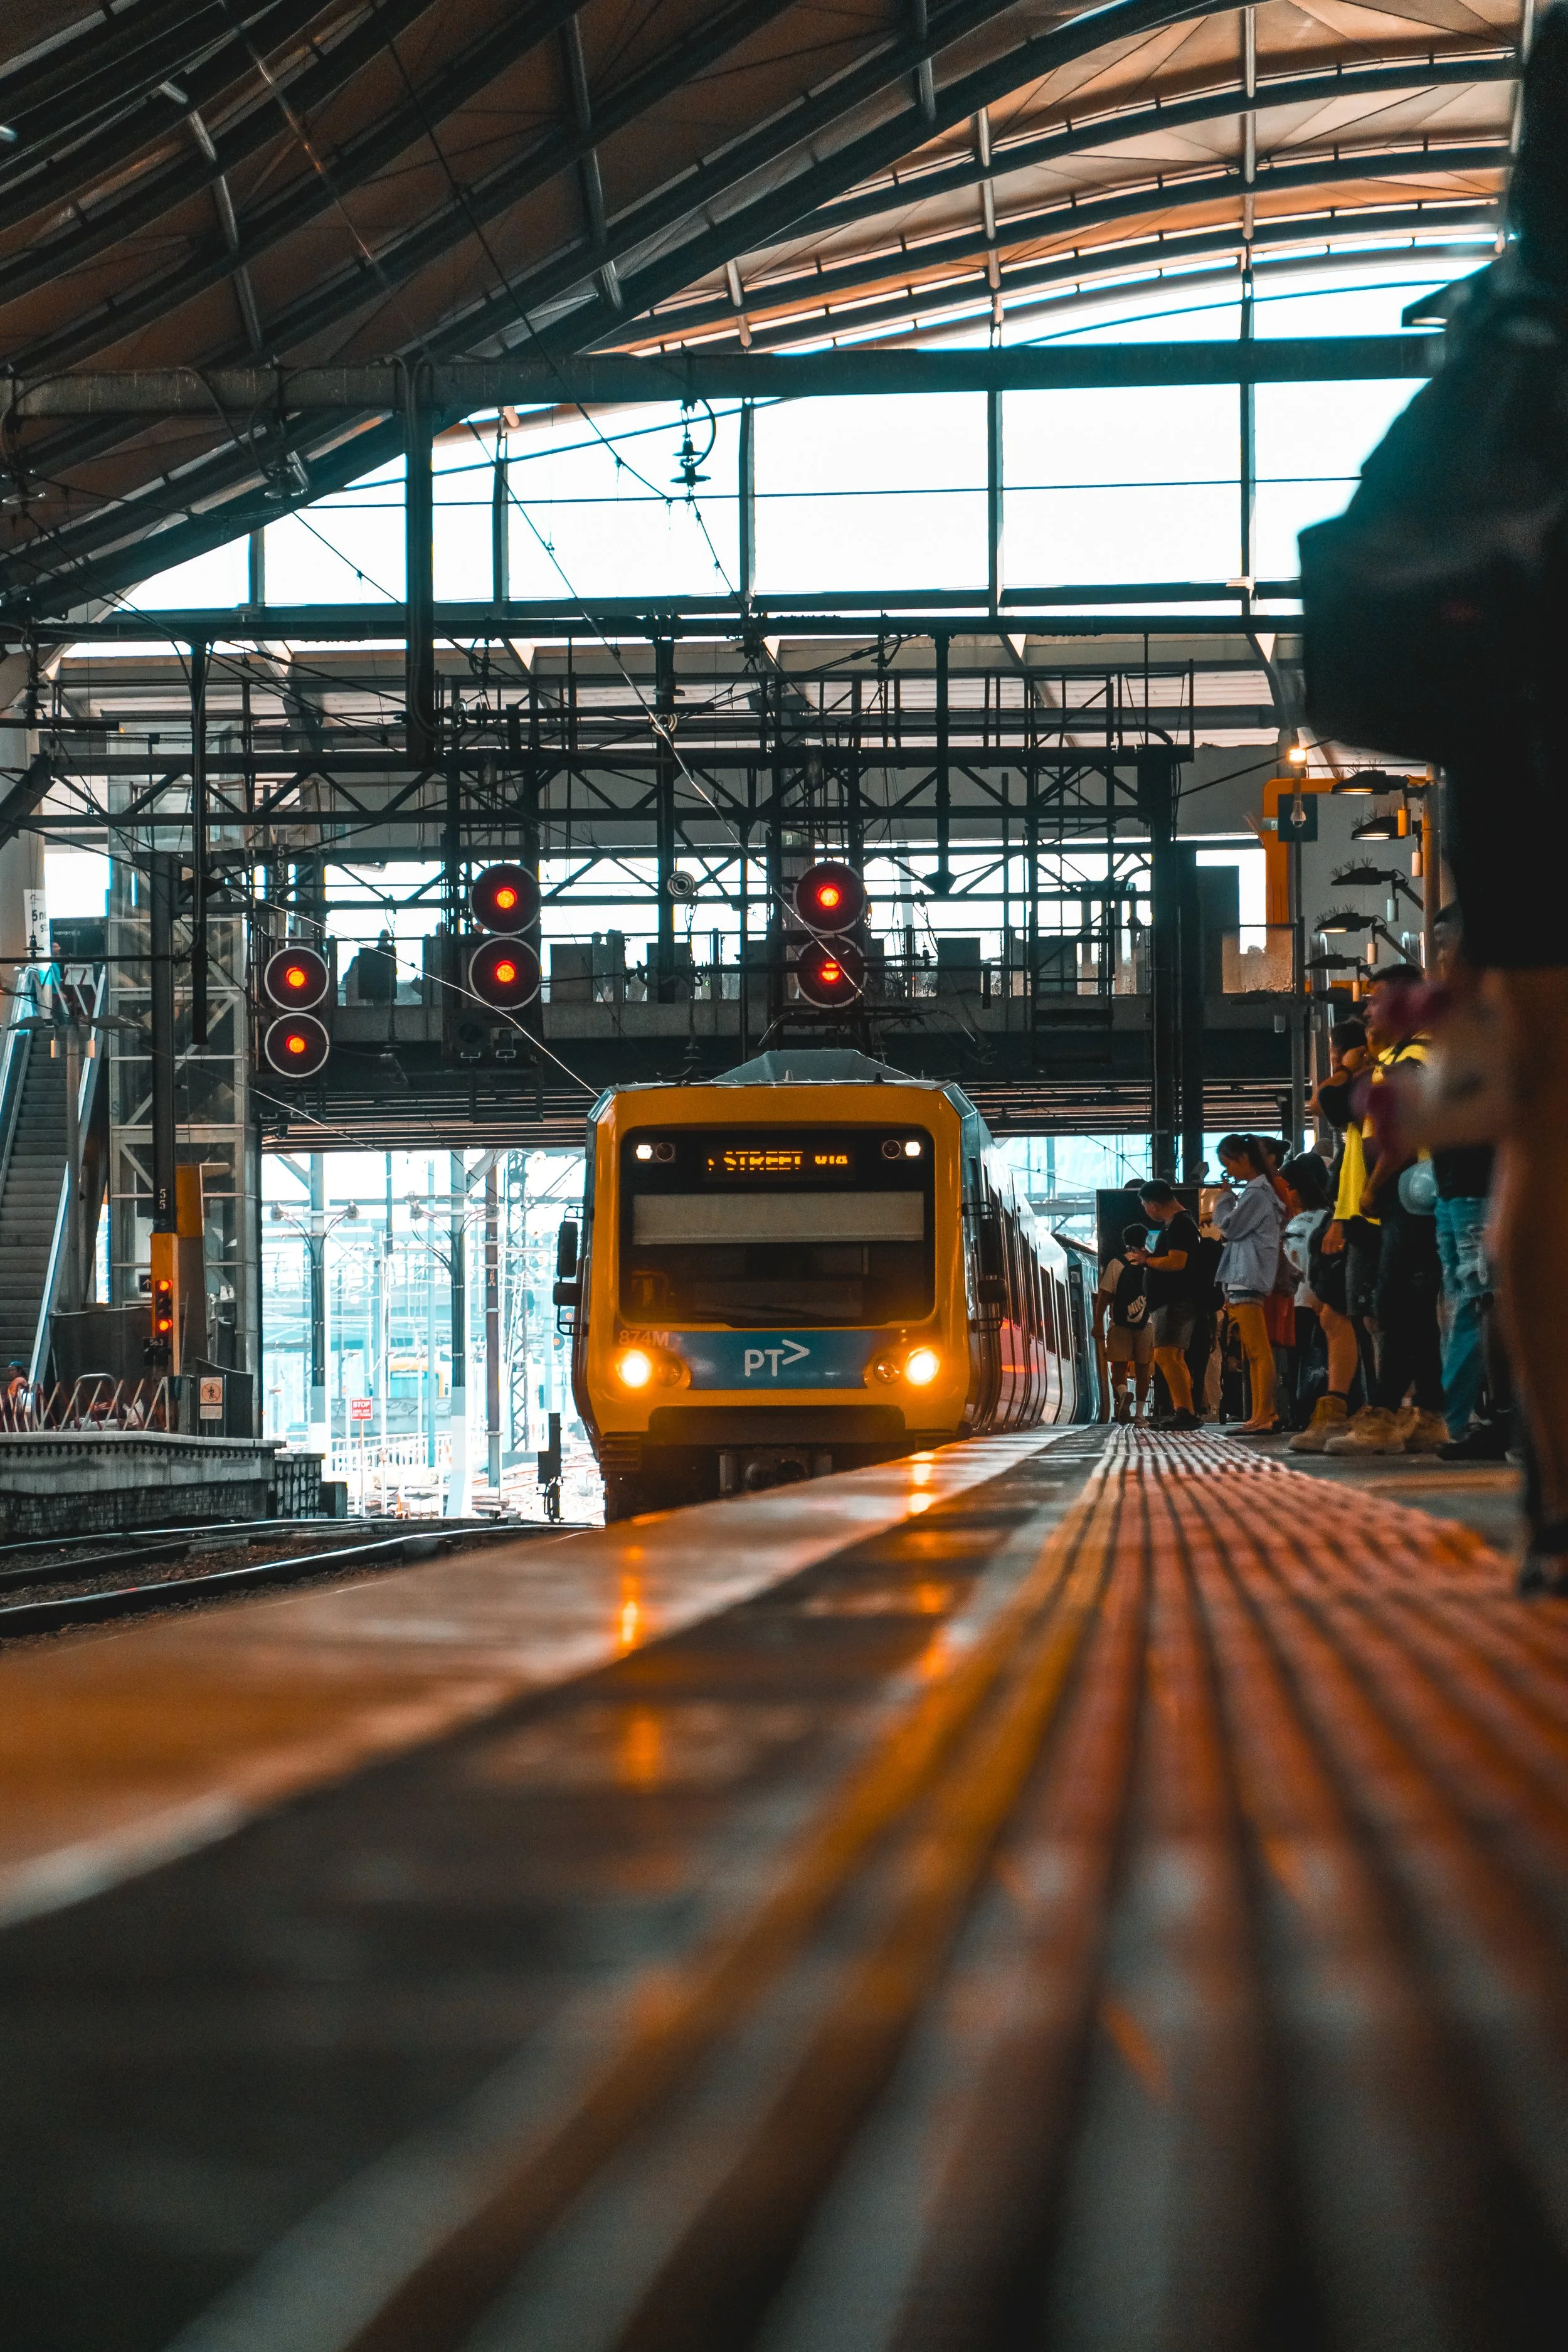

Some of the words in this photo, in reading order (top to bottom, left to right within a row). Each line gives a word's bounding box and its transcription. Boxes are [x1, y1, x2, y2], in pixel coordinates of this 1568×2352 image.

[159, 1189, 166, 1210] 55
[618, 1330, 669, 1347] 874M
[352, 1401, 371, 1409] STOP
